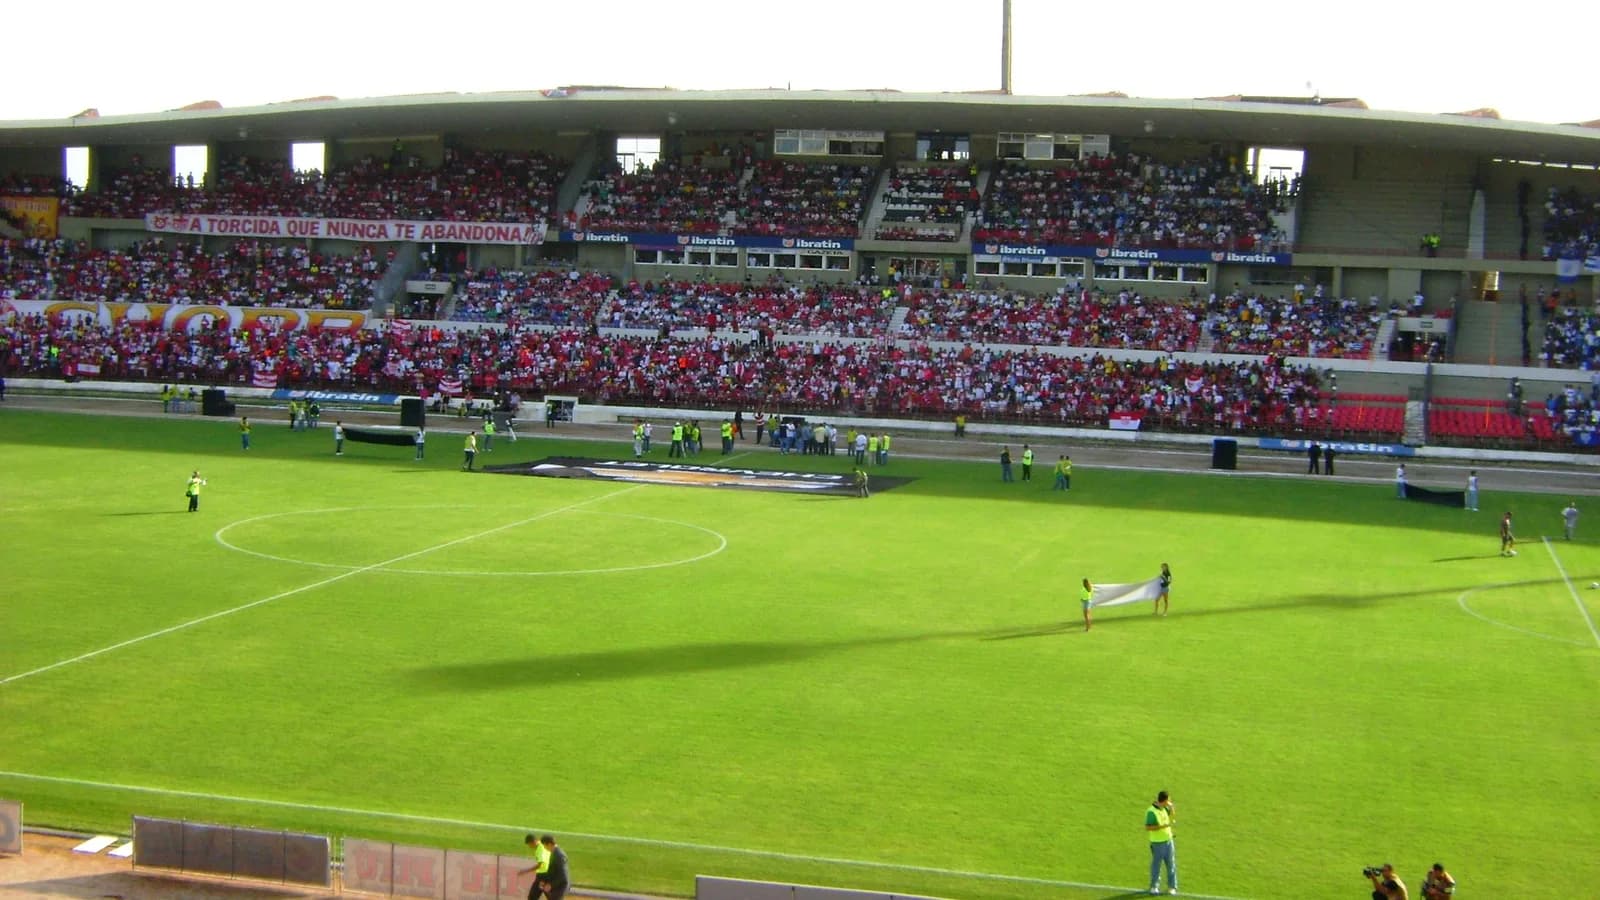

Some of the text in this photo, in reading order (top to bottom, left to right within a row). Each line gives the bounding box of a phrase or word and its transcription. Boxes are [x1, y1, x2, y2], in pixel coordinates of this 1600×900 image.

[190, 217, 202, 231] A
[207, 218, 281, 234] TORCIDA
[287, 220, 320, 236] QUE
[327, 221, 388, 239] NUNCA
[395, 223, 415, 239] TE
[586, 232, 629, 242] ibratin
[691, 236, 736, 246] ibratin
[796, 239, 841, 249] ibratin
[1000, 245, 1046, 255] ibratin
[1111, 249, 1158, 259] ibratin
[1226, 252, 1276, 263] ibratin
[306, 390, 379, 401] ibratin
